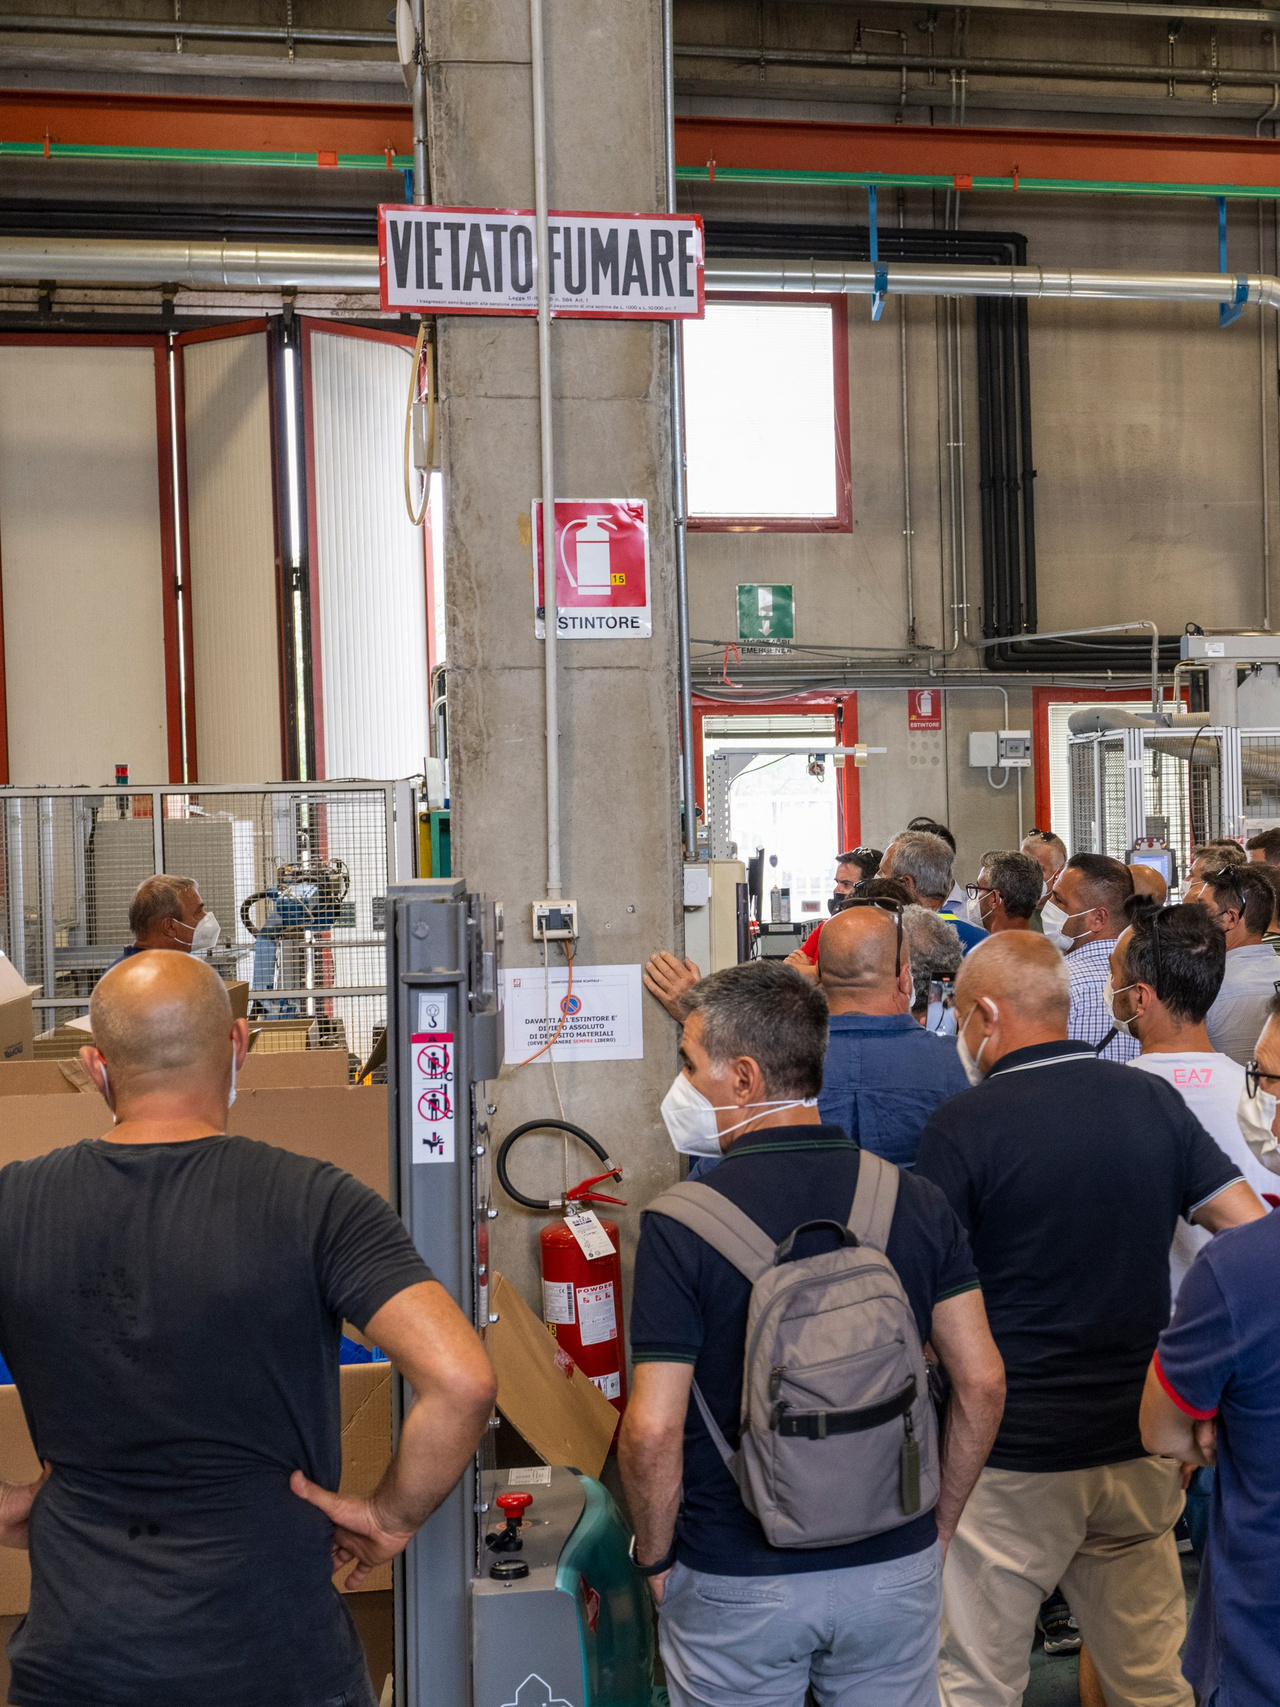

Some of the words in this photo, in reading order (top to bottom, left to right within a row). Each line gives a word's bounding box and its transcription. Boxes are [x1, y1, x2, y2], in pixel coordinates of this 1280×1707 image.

[389, 220, 533, 294] VIETATO
[548, 226, 695, 297] FUMARE
[613, 574, 624, 584] 15
[558, 616, 641, 630] STINTORE
[569, 1023, 605, 1031] ASSOLUTO
[576, 1030, 614, 1038] MATERIALI
[1173, 1067, 1213, 1084] EA7
[577, 1282, 613, 1295] POWDER
